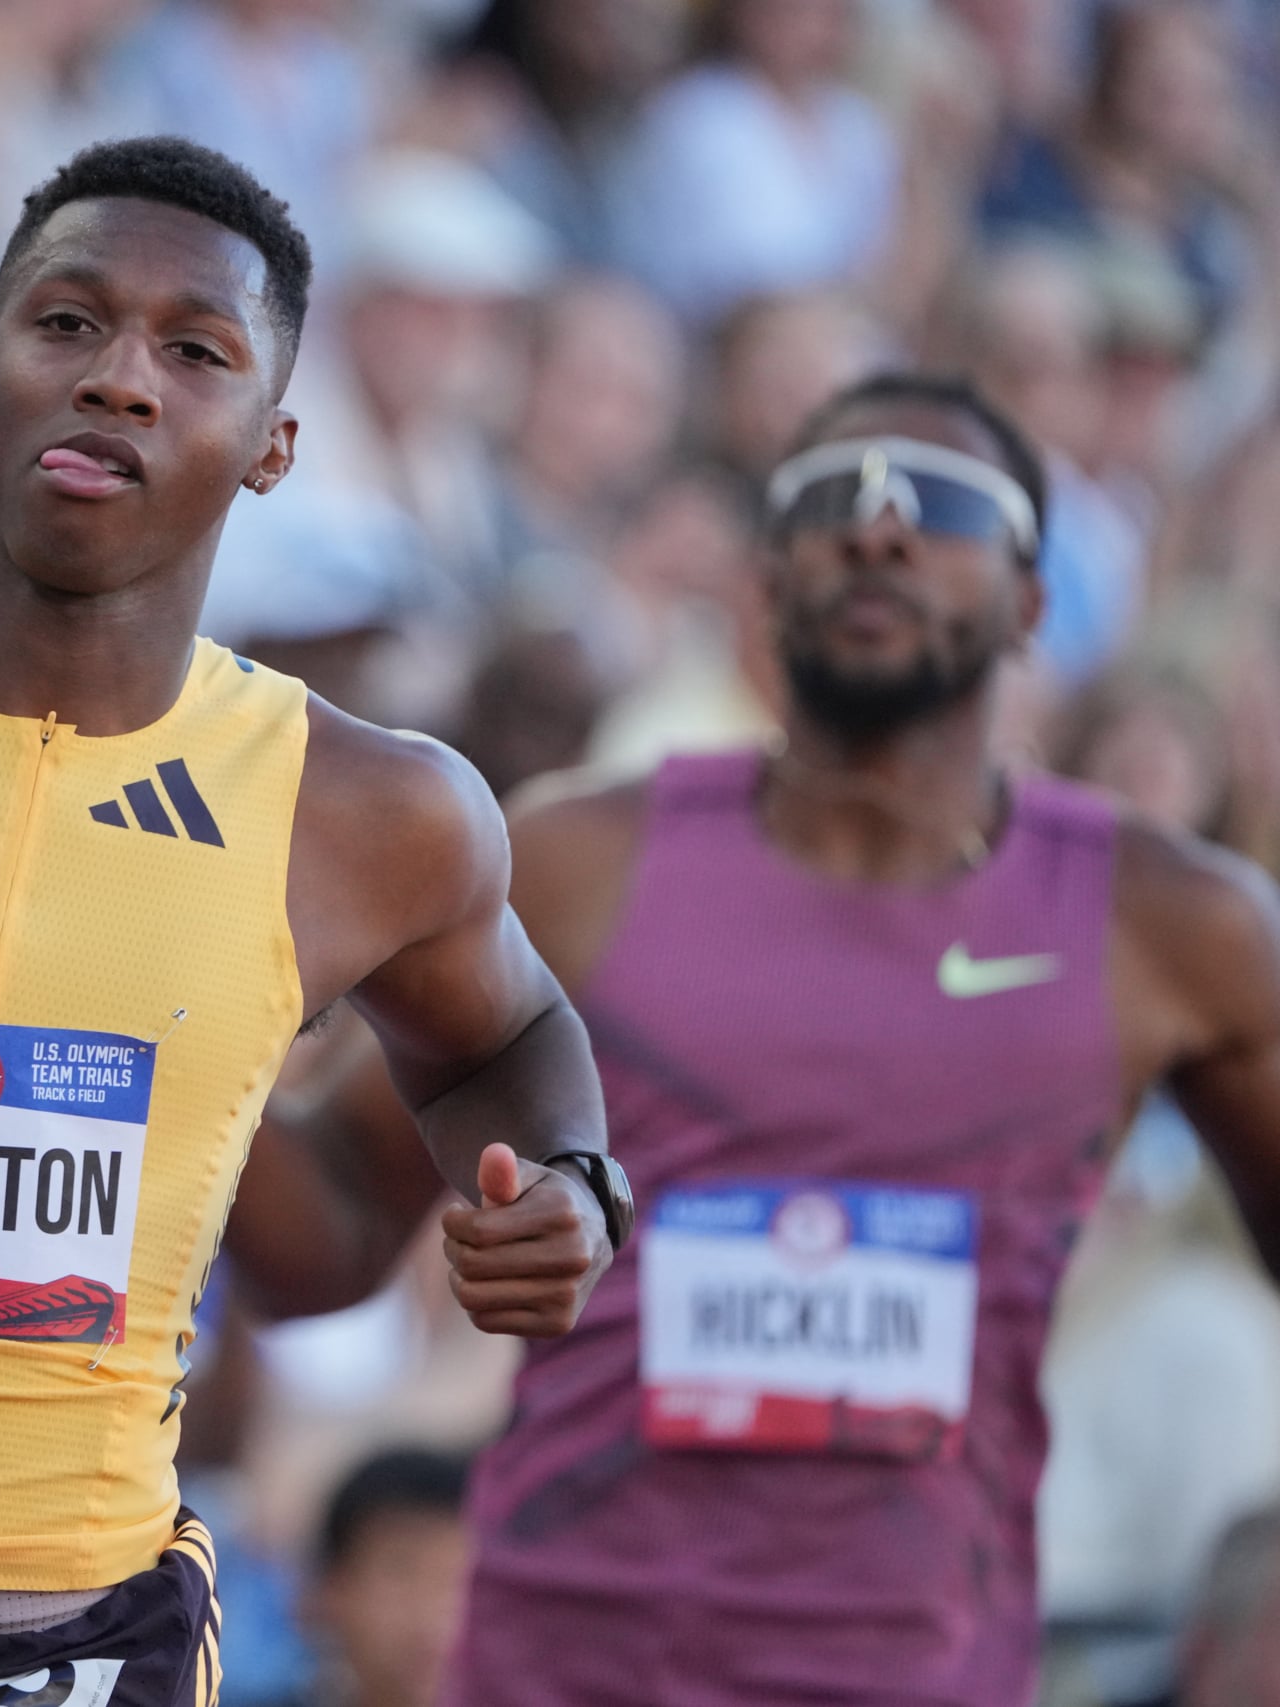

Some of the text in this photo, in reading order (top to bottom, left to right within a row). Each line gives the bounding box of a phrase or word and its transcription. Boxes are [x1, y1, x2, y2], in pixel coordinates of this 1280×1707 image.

[32, 1041, 135, 1066] U.S. OLYMPIC
[31, 1064, 133, 1088] TEAM TRIALS
[31, 1086, 106, 1103] TRACK & FIELD
